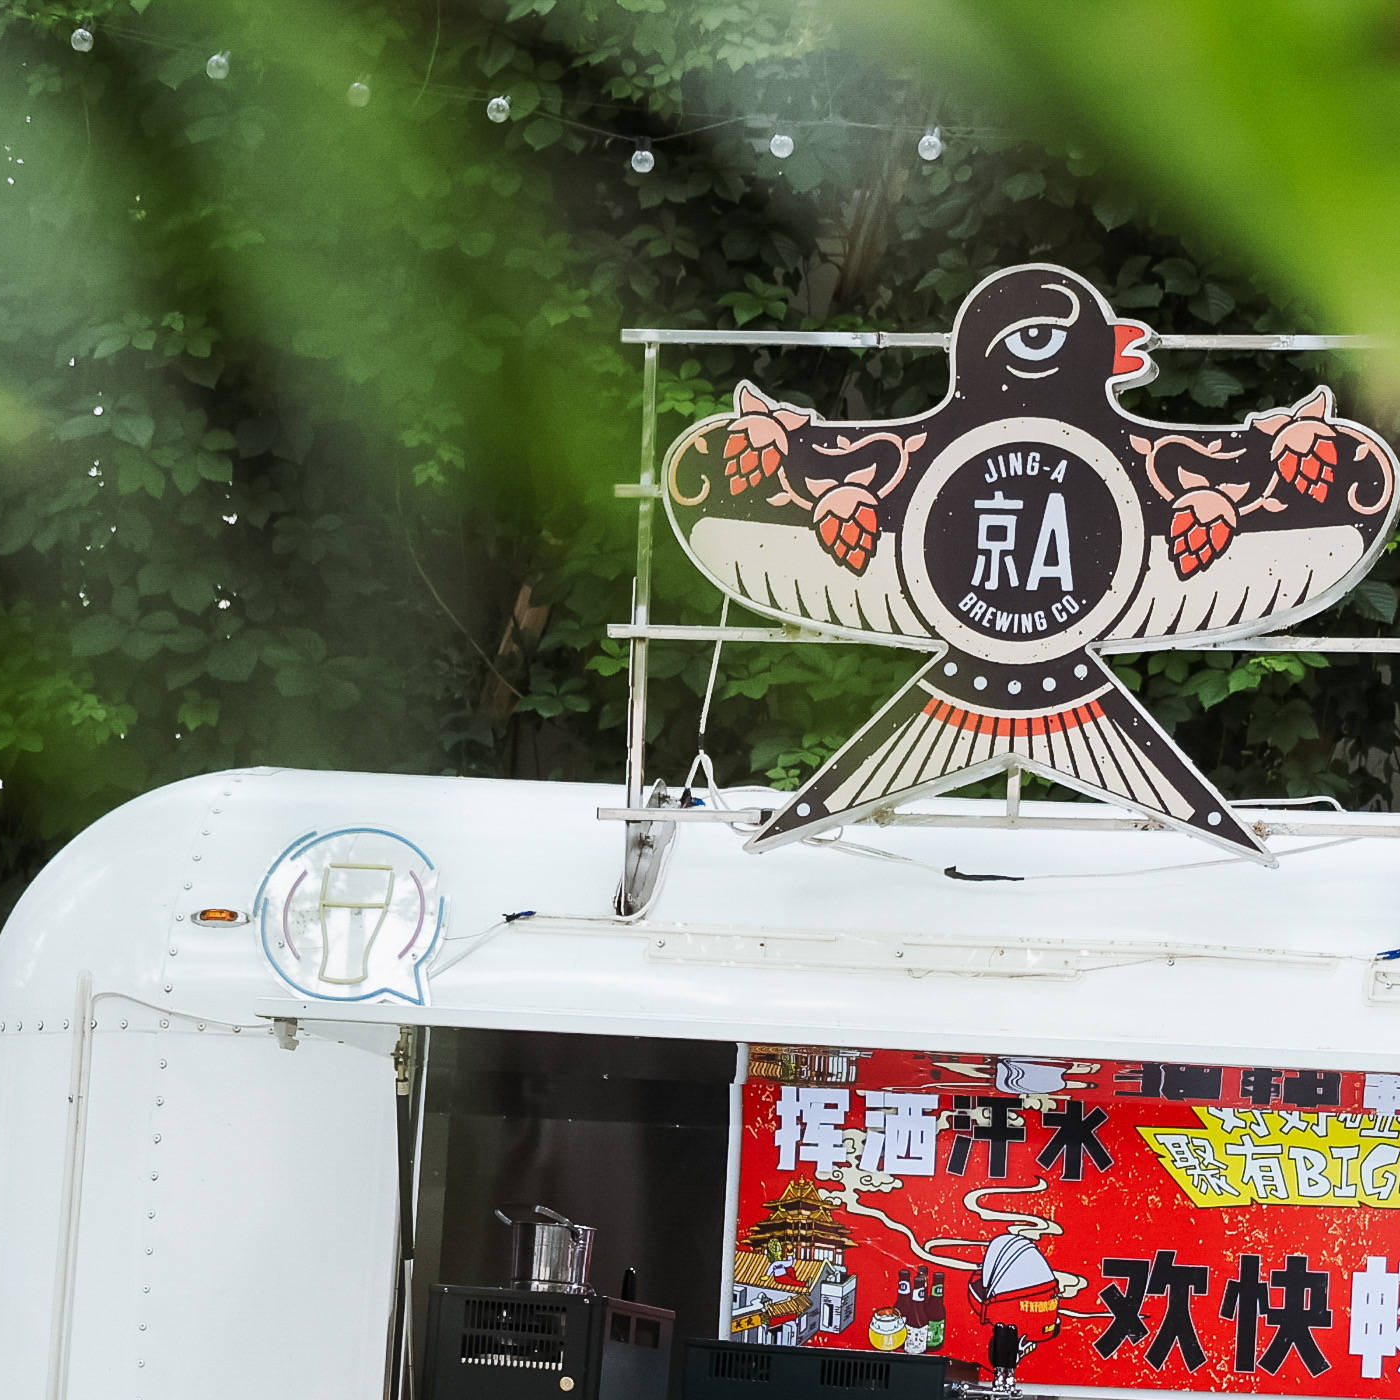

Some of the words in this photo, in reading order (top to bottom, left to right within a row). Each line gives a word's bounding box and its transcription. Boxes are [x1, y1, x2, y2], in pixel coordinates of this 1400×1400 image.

[984, 452, 1068, 484] JING-A
[958, 592, 1048, 634] BREWING
[1051, 594, 1087, 624] CO.
[774, 1085, 1115, 1182] 挥洒汗水
